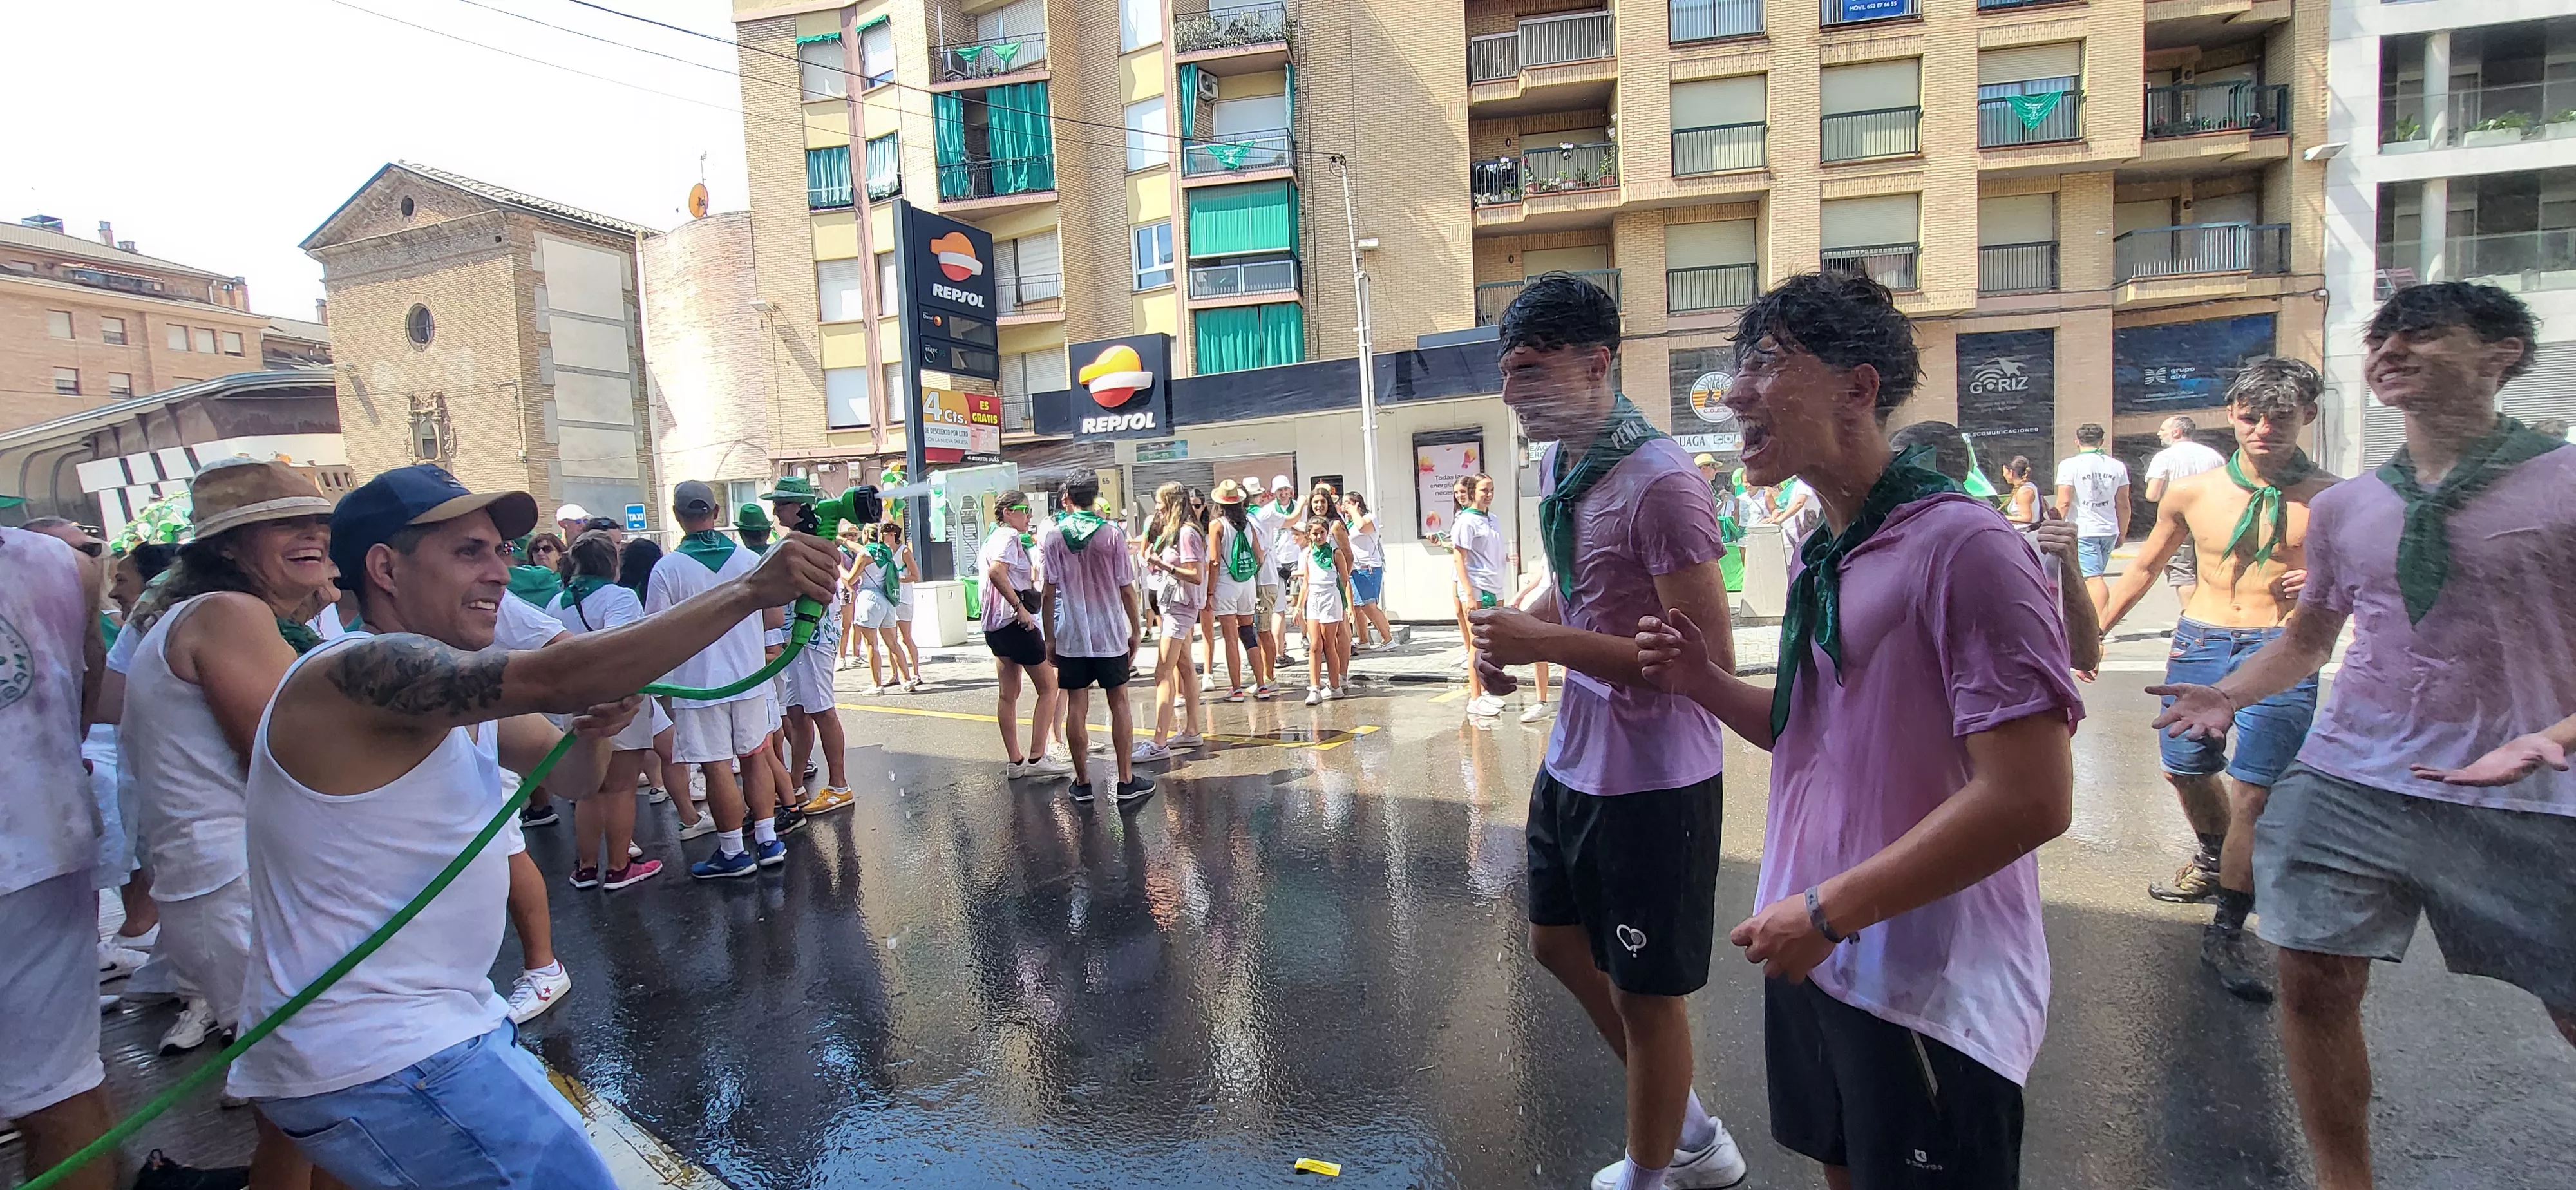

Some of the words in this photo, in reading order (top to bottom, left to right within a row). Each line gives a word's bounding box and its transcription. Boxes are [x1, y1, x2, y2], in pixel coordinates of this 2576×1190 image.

[932, 283, 985, 308] REPSOL
[923, 390, 942, 422] 4
[944, 409, 968, 424] Cts.
[980, 400, 989, 411] ES
[972, 412, 998, 424] GRATIS
[1082, 412, 1156, 434] REPSOL
[1611, 420, 1645, 449] PEÑA
[1966, 427, 2039, 437] LECOMUNICACIONES
[1679, 437, 1706, 447] UAGA
[627, 513, 644, 522] TAXI
